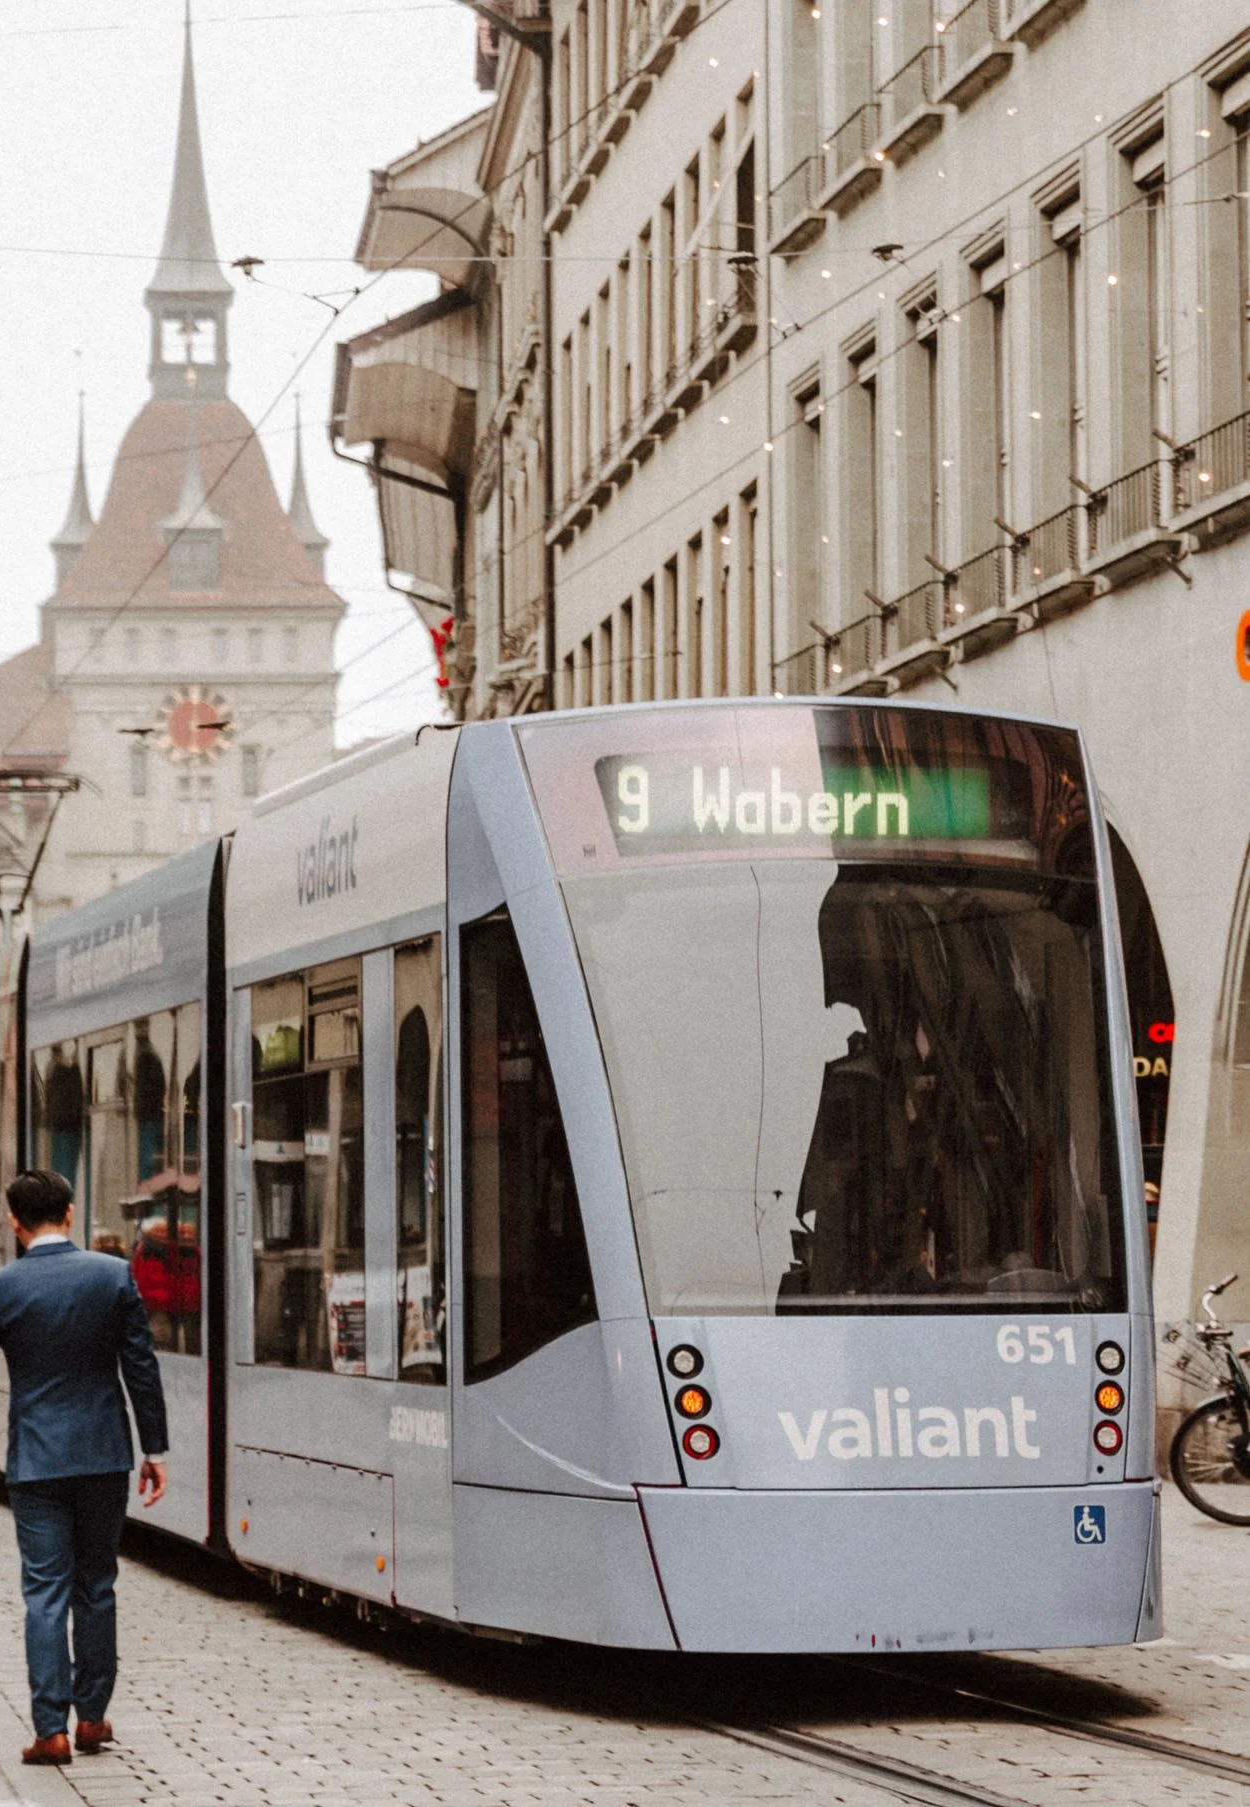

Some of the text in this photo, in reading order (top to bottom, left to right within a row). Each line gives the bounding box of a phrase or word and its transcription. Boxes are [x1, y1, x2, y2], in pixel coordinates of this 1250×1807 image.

[617, 764, 909, 835] 9 Wabern
[296, 813, 358, 906] valiant
[996, 1325, 1076, 1365] 651
[777, 1386, 1041, 1460] valiant
